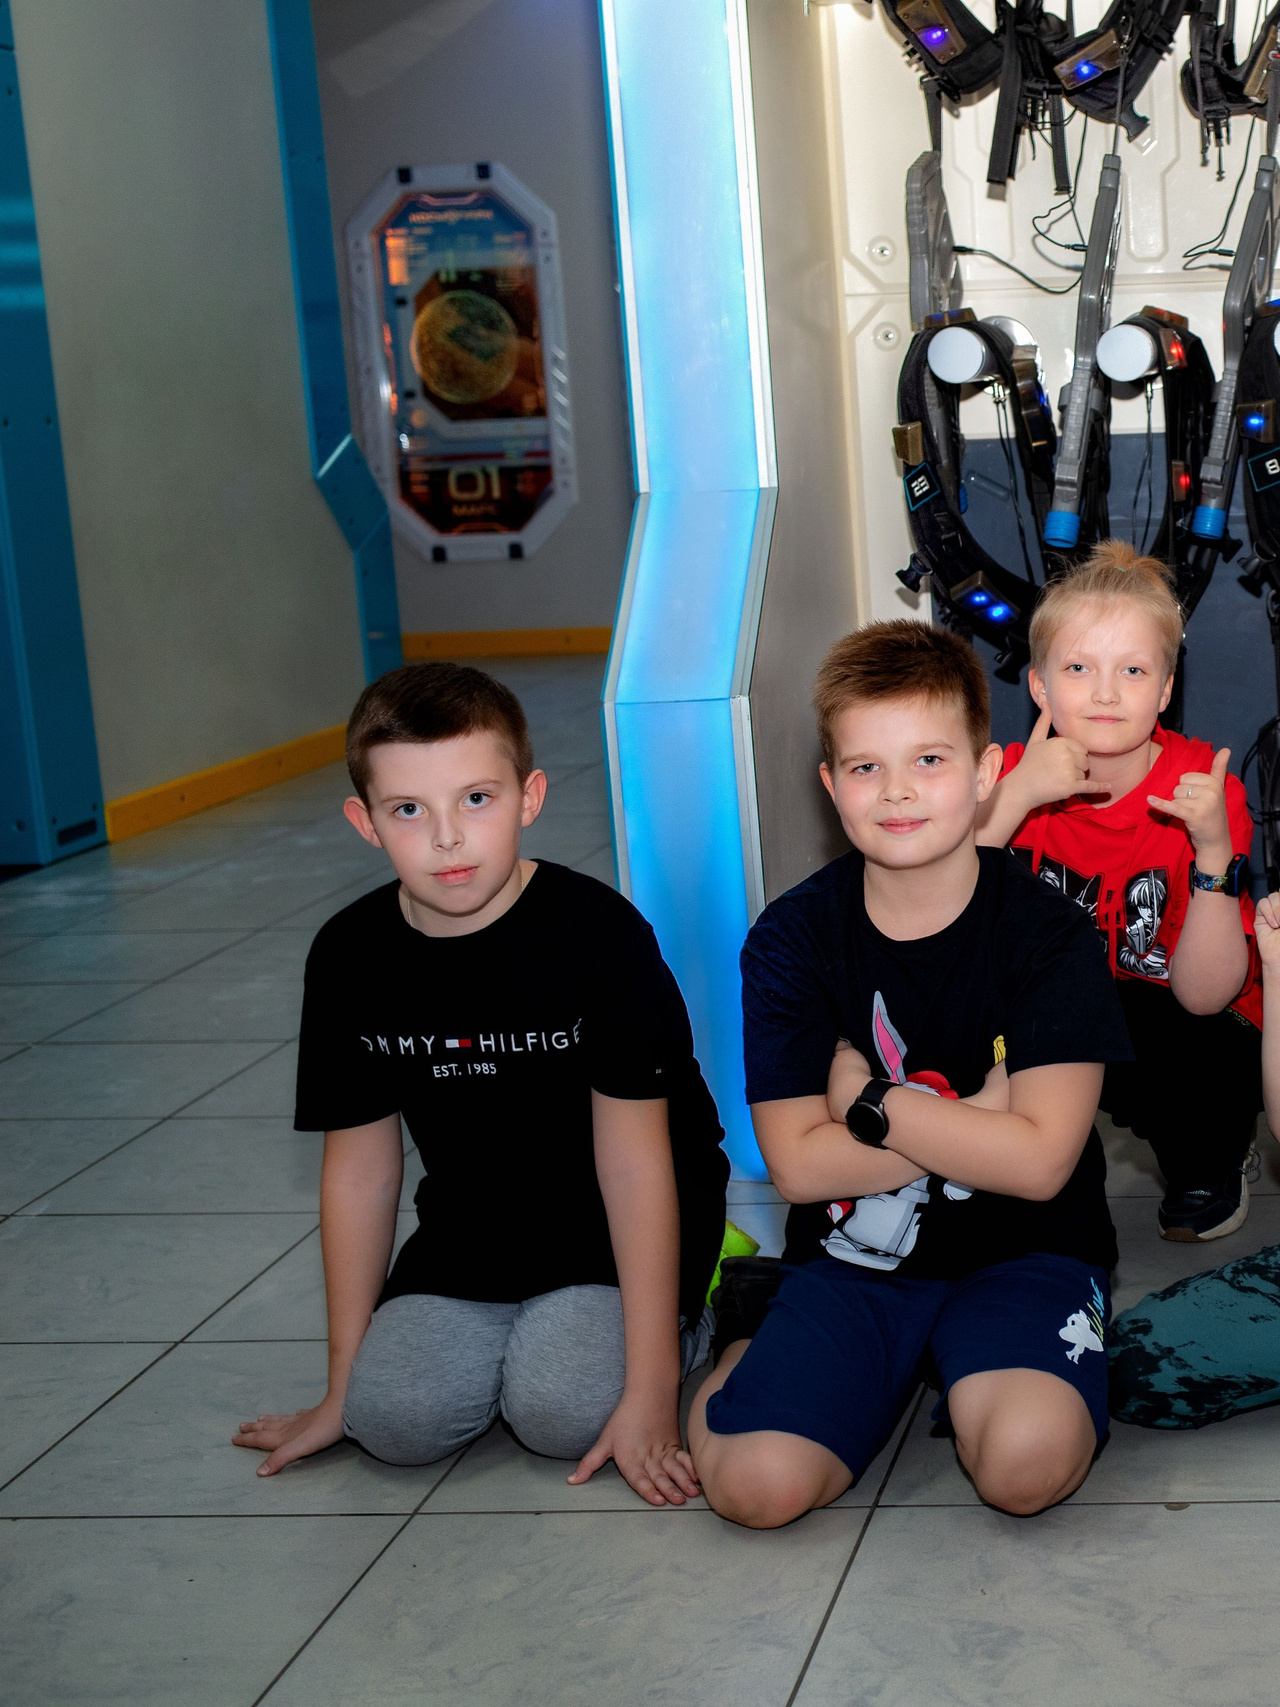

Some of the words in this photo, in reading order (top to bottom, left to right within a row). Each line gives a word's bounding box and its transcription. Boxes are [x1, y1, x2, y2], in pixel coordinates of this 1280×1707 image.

[1265, 458, 1280, 475] 8
[911, 475, 930, 497] 23
[433, 1063, 462, 1078] EST.
[468, 1063, 497, 1077] 1985
